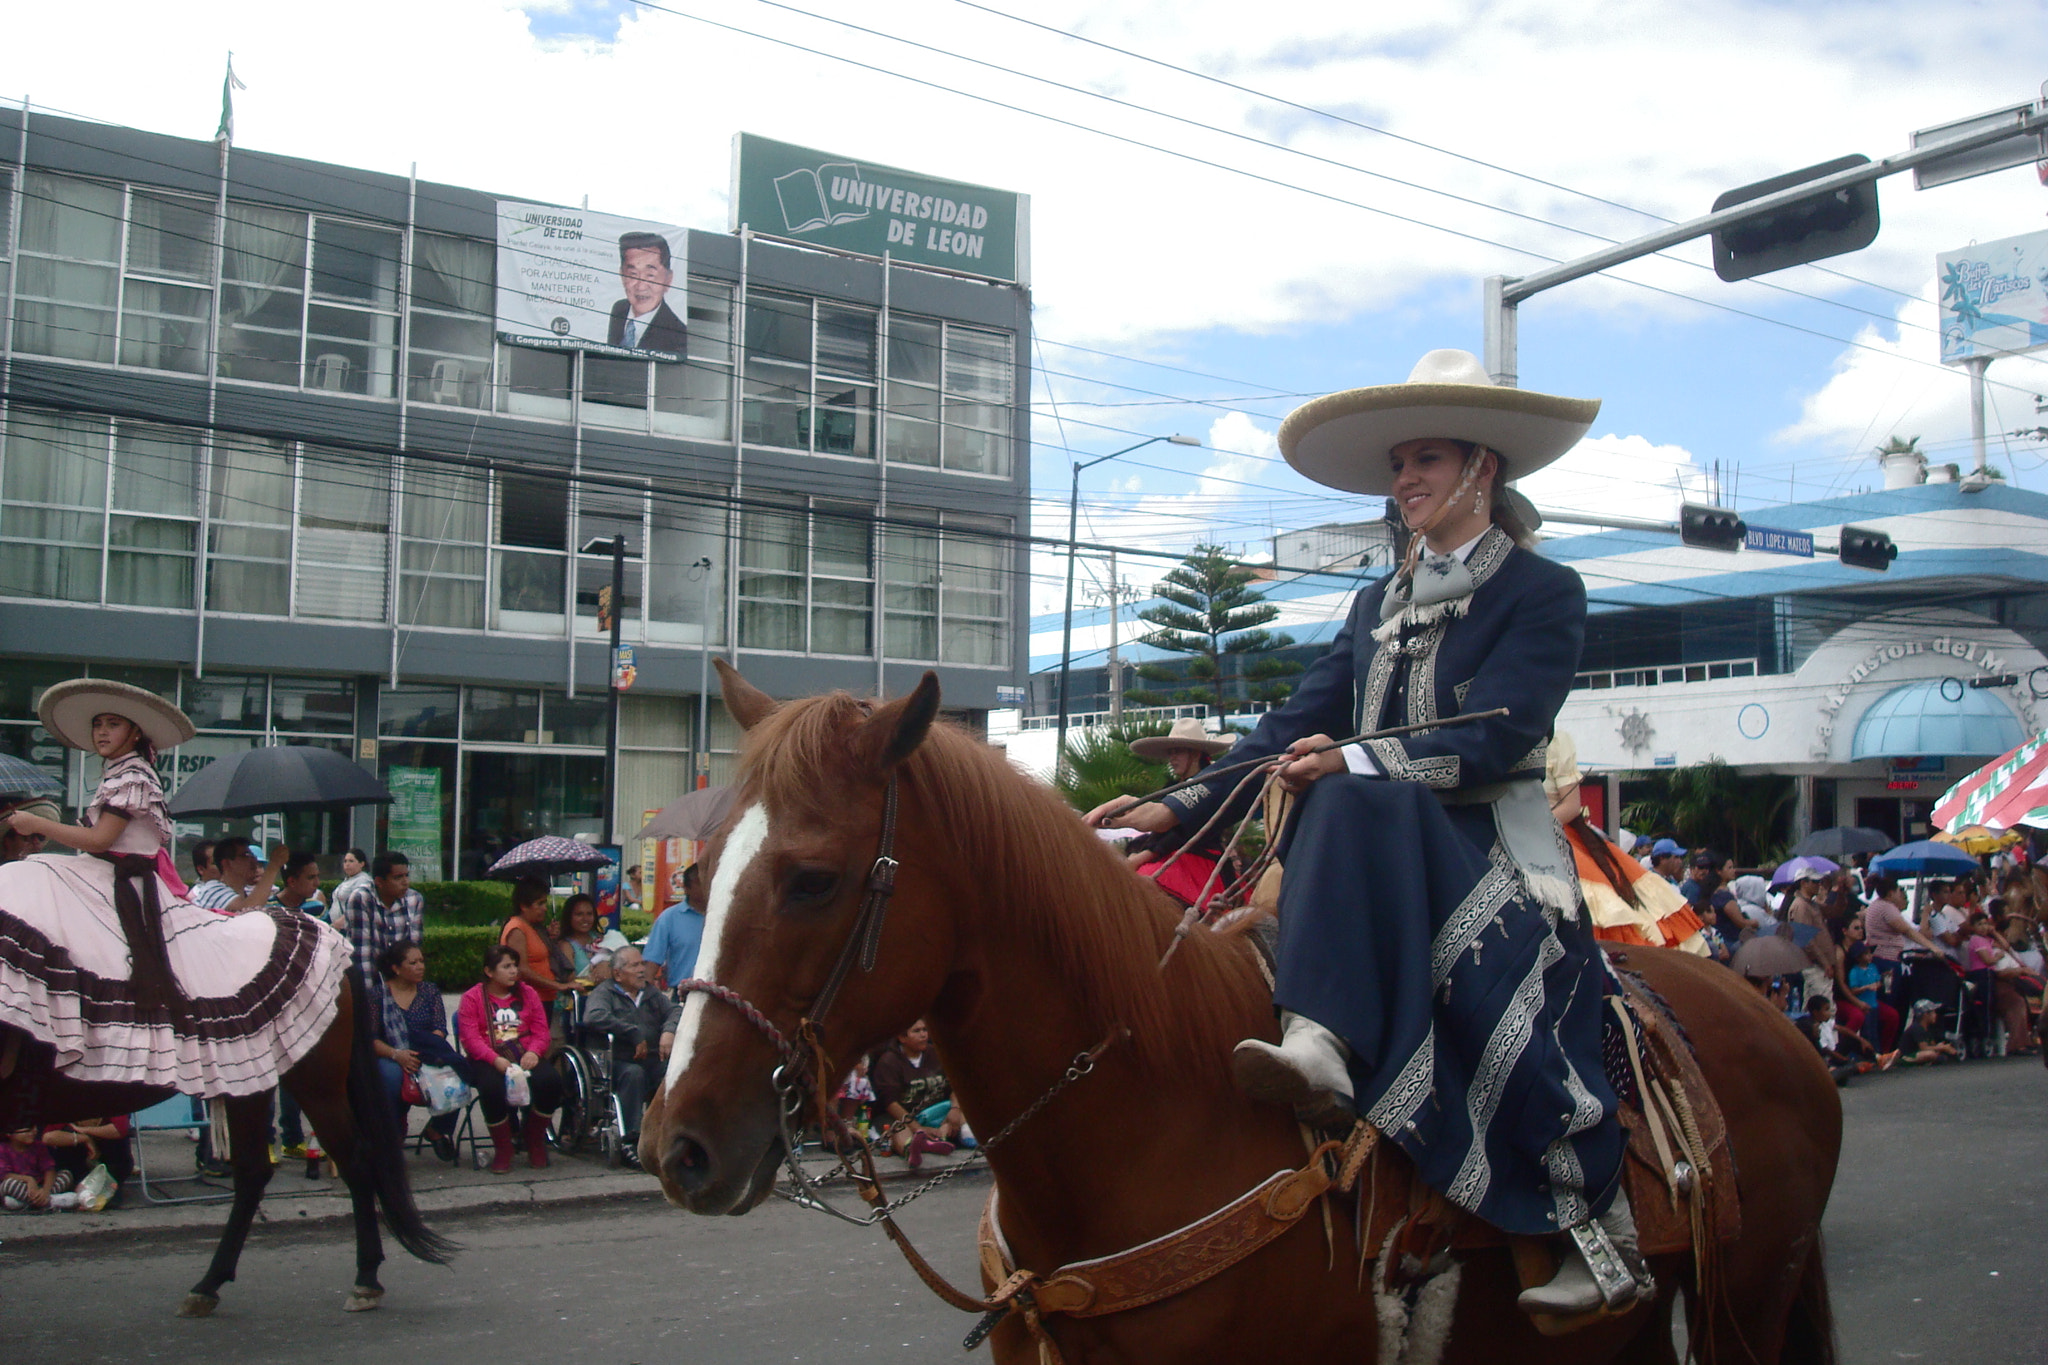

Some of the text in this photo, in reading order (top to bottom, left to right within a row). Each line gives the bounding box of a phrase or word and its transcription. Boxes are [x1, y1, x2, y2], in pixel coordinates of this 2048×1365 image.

[830, 176, 988, 230] UNIVERSIDAD
[525, 213, 583, 228] UNIVERSIDAD
[543, 228, 583, 240] DE LEON
[887, 219, 985, 259] DE LEON
[521, 267, 600, 284] POR AYUDARME A
[1955, 259, 1990, 284] Buffet
[531, 282, 591, 294] MANTENER A
[1979, 274, 2031, 304] Mariscos
[565, 296, 596, 308] LIMPIO
[516, 335, 559, 347] Congreso
[560, 339, 631, 356] Multidisciplinario
[1747, 530, 1811, 553] BLVD LOPEZ MATEOS
[1819, 641, 1924, 719] Mansion
[1932, 636, 1979, 662] del
[1887, 781, 1919, 790] ABIERTO
